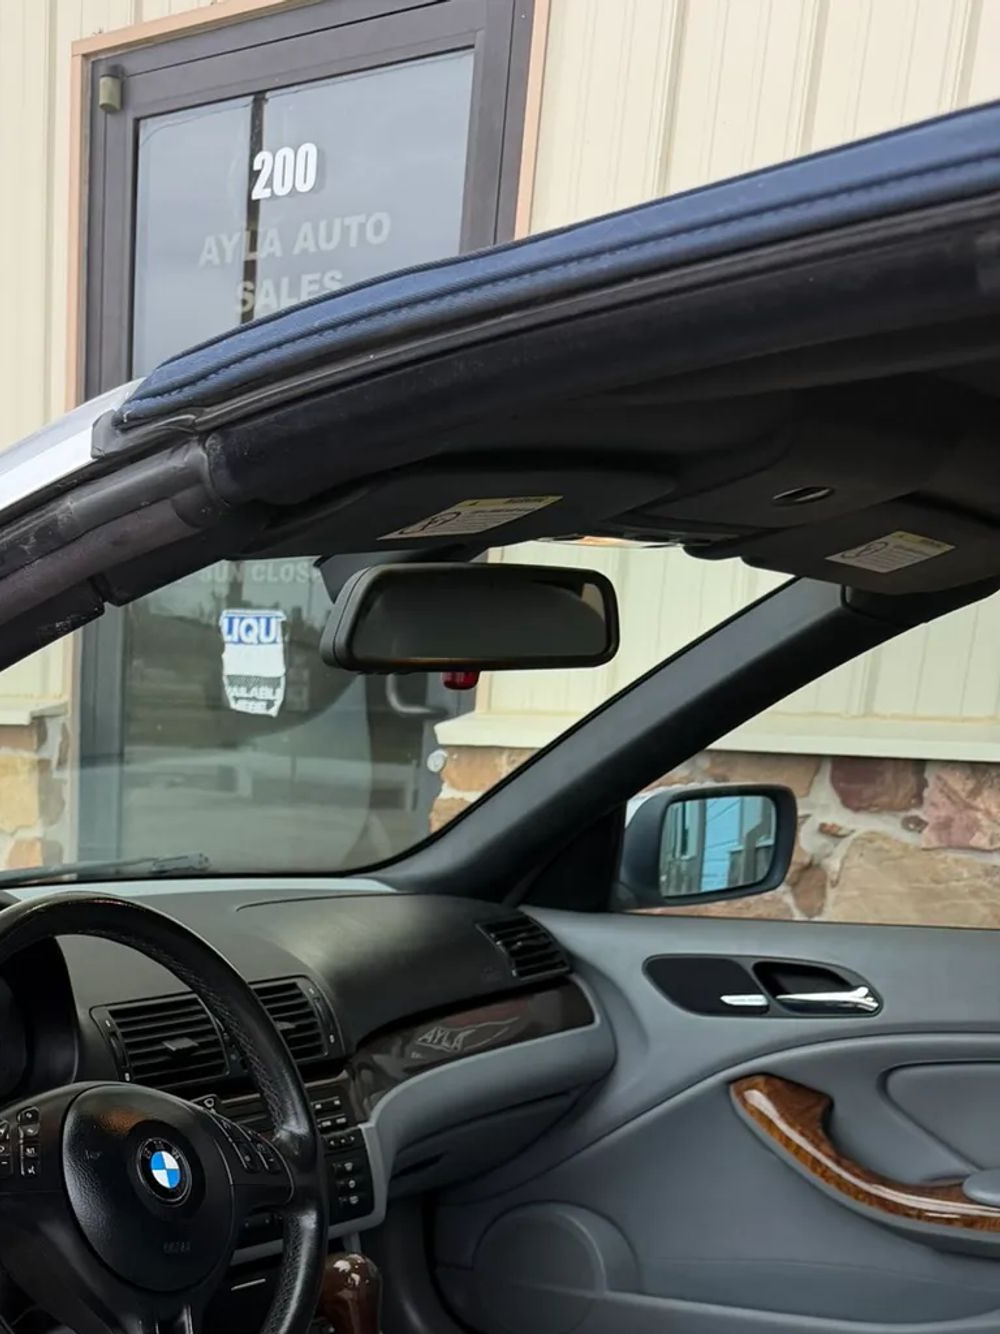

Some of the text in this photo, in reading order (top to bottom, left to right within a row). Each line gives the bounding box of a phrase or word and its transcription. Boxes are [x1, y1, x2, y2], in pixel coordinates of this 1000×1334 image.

[251, 142, 319, 200] 200
[199, 211, 392, 268] AYLA AUTO
[234, 269, 344, 313] SALES
